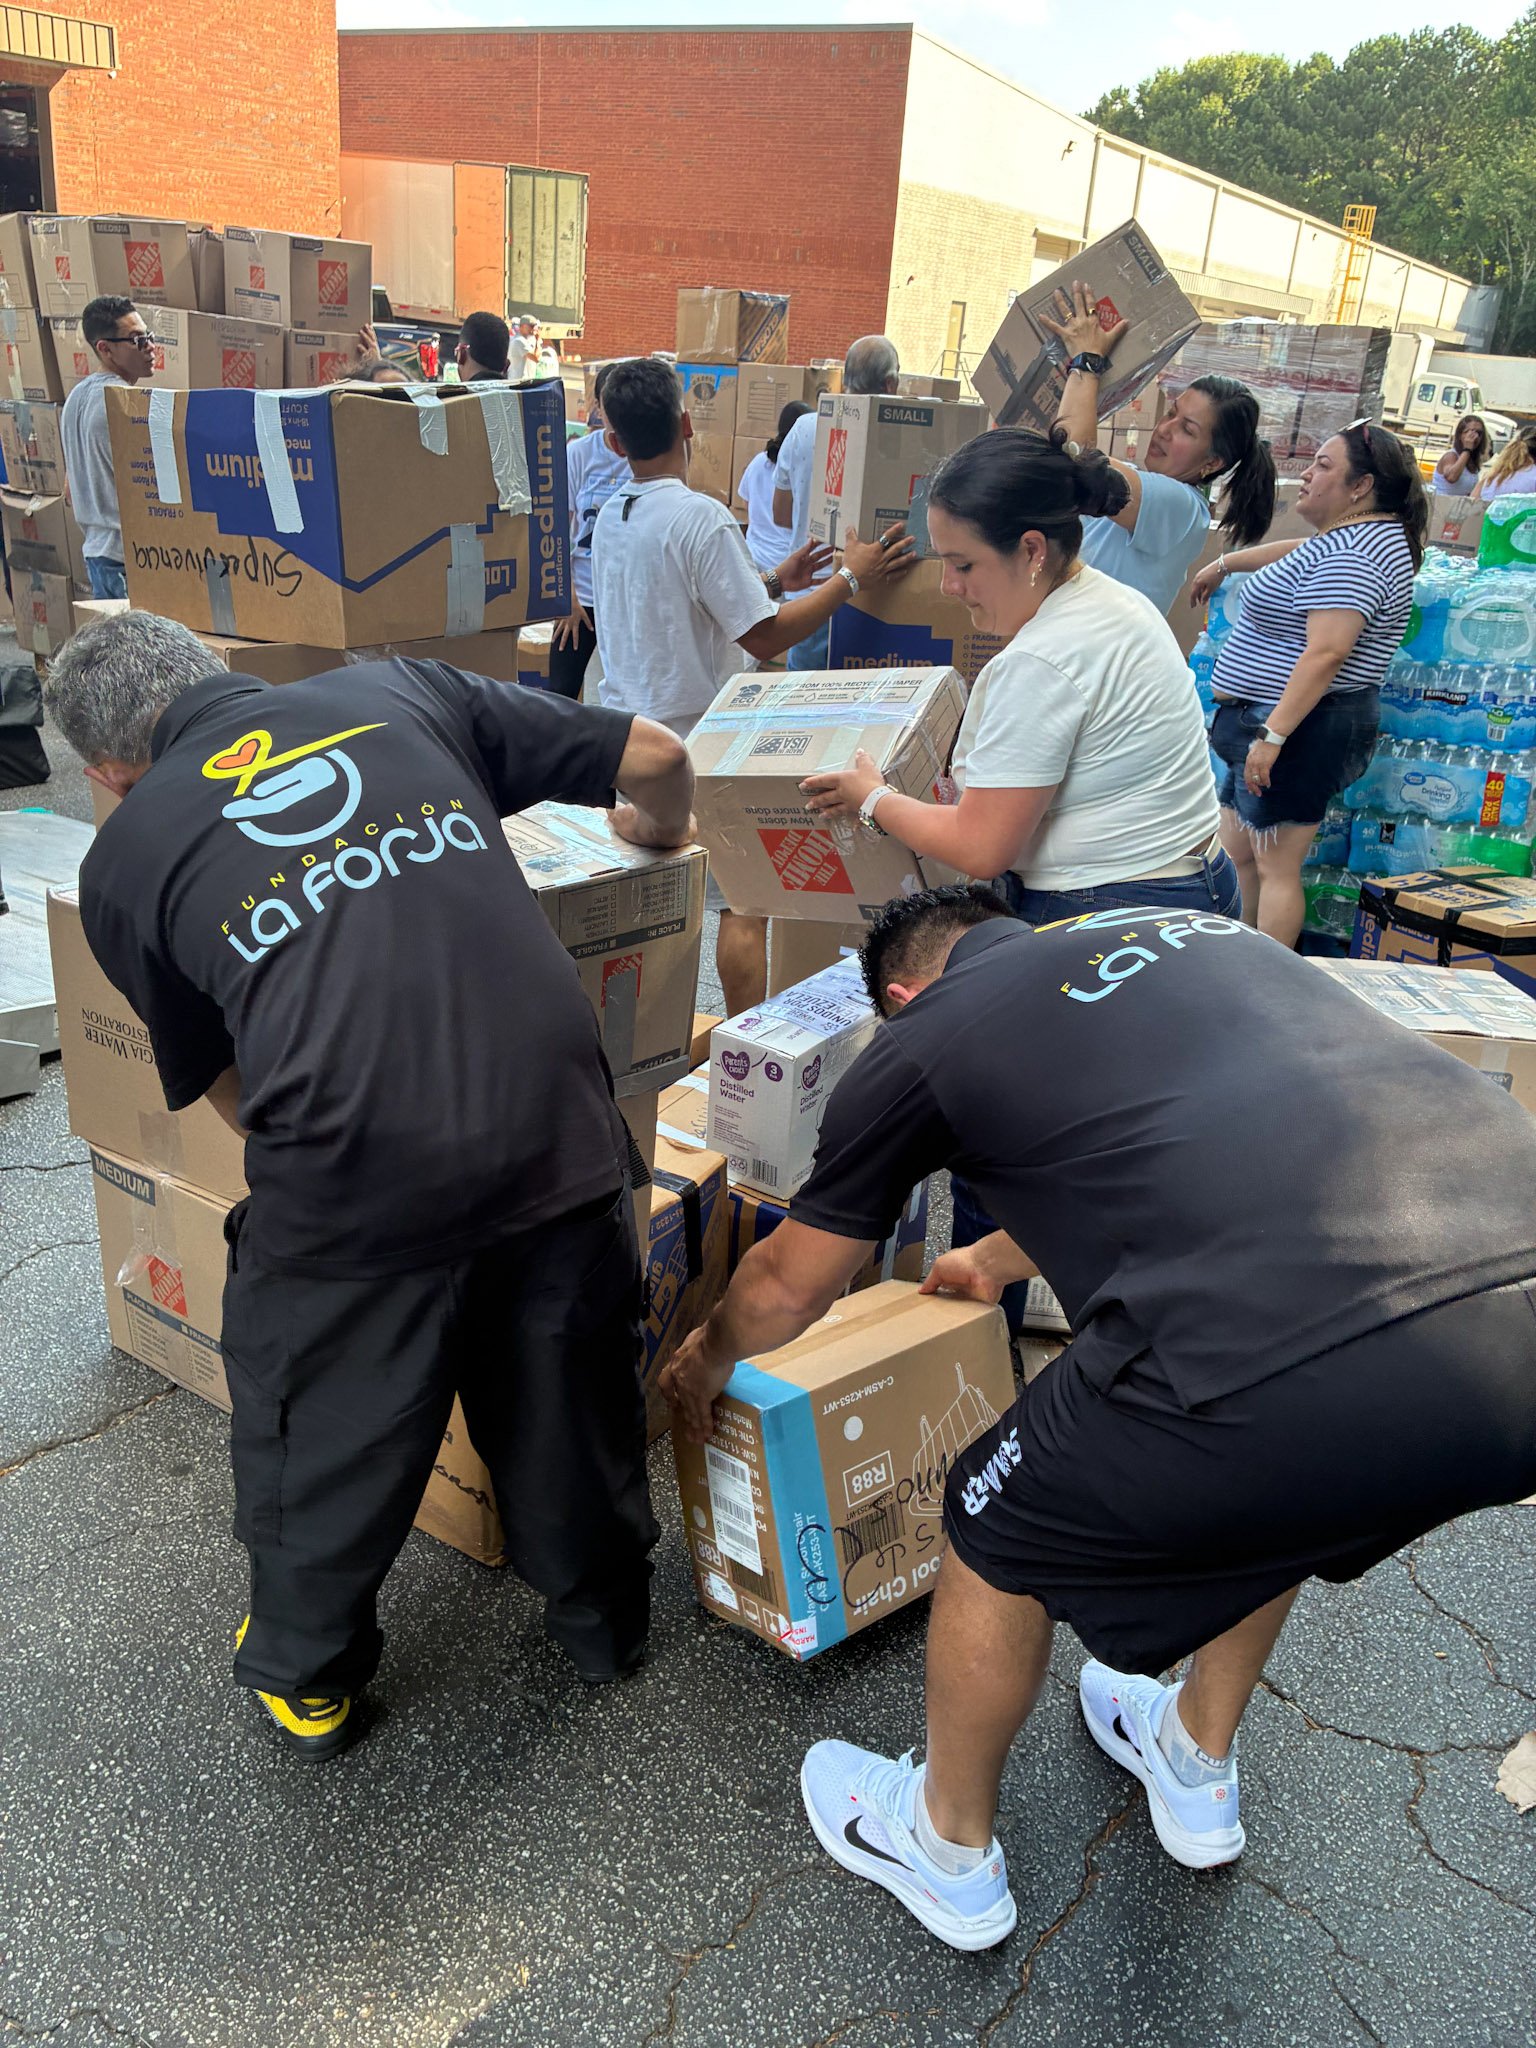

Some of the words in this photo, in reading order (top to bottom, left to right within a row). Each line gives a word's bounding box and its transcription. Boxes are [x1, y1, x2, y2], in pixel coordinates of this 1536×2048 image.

[129, 243, 159, 286] HOME
[1129, 235, 1159, 283] SMALL
[319, 262, 347, 304] HOME
[131, 416, 149, 424] ment
[883, 408, 928, 424] SMALL
[206, 453, 314, 488] mdium
[148, 507, 176, 518] FRAGILE
[533, 424, 557, 600] medium
[1426, 690, 1467, 701] KIRKLAND
[784, 737, 808, 749] USA
[1422, 787, 1451, 799] Drinking
[1487, 780, 1504, 791] 40
[758, 817, 788, 826] doers
[772, 807, 800, 815] more
[790, 817, 815, 826] How
[771, 830, 803, 868] DEPOT
[220, 799, 464, 935] FUNDACIÓN
[782, 830, 834, 890] HOME
[814, 863, 838, 886] THE
[227, 898, 302, 963] La
[302, 812, 488, 914] Forja
[658, 922, 681, 935] PLACE
[576, 941, 609, 957] FRAGILE
[783, 998, 808, 1009] POR
[786, 991, 860, 1021] VENEZUELA
[82, 1008, 149, 1043] ESTORATION
[807, 1005, 852, 1026] UNIDOS
[131, 1044, 154, 1065] GIA
[724, 1055, 748, 1068] Parent's
[770, 1065, 778, 1075] 3
[720, 1079, 755, 1098] Distilled
[720, 1088, 746, 1104] Water
[800, 1085, 823, 1106] Distilled
[800, 1099, 817, 1115] Water
[94, 1155, 150, 1200] MEDIUM
[153, 1268, 181, 1302] HOME
[189, 1330, 218, 1349] FRAGILE
[822, 1375, 894, 1415] C-ASM-K253-WT
[740, 1414, 753, 1430] Made
[738, 1430, 755, 1445] CTN:
[852, 1462, 888, 1495] R88
[697, 1539, 722, 1568] R88
[913, 1553, 945, 1589] ool
[853, 1574, 907, 1616] Chair
